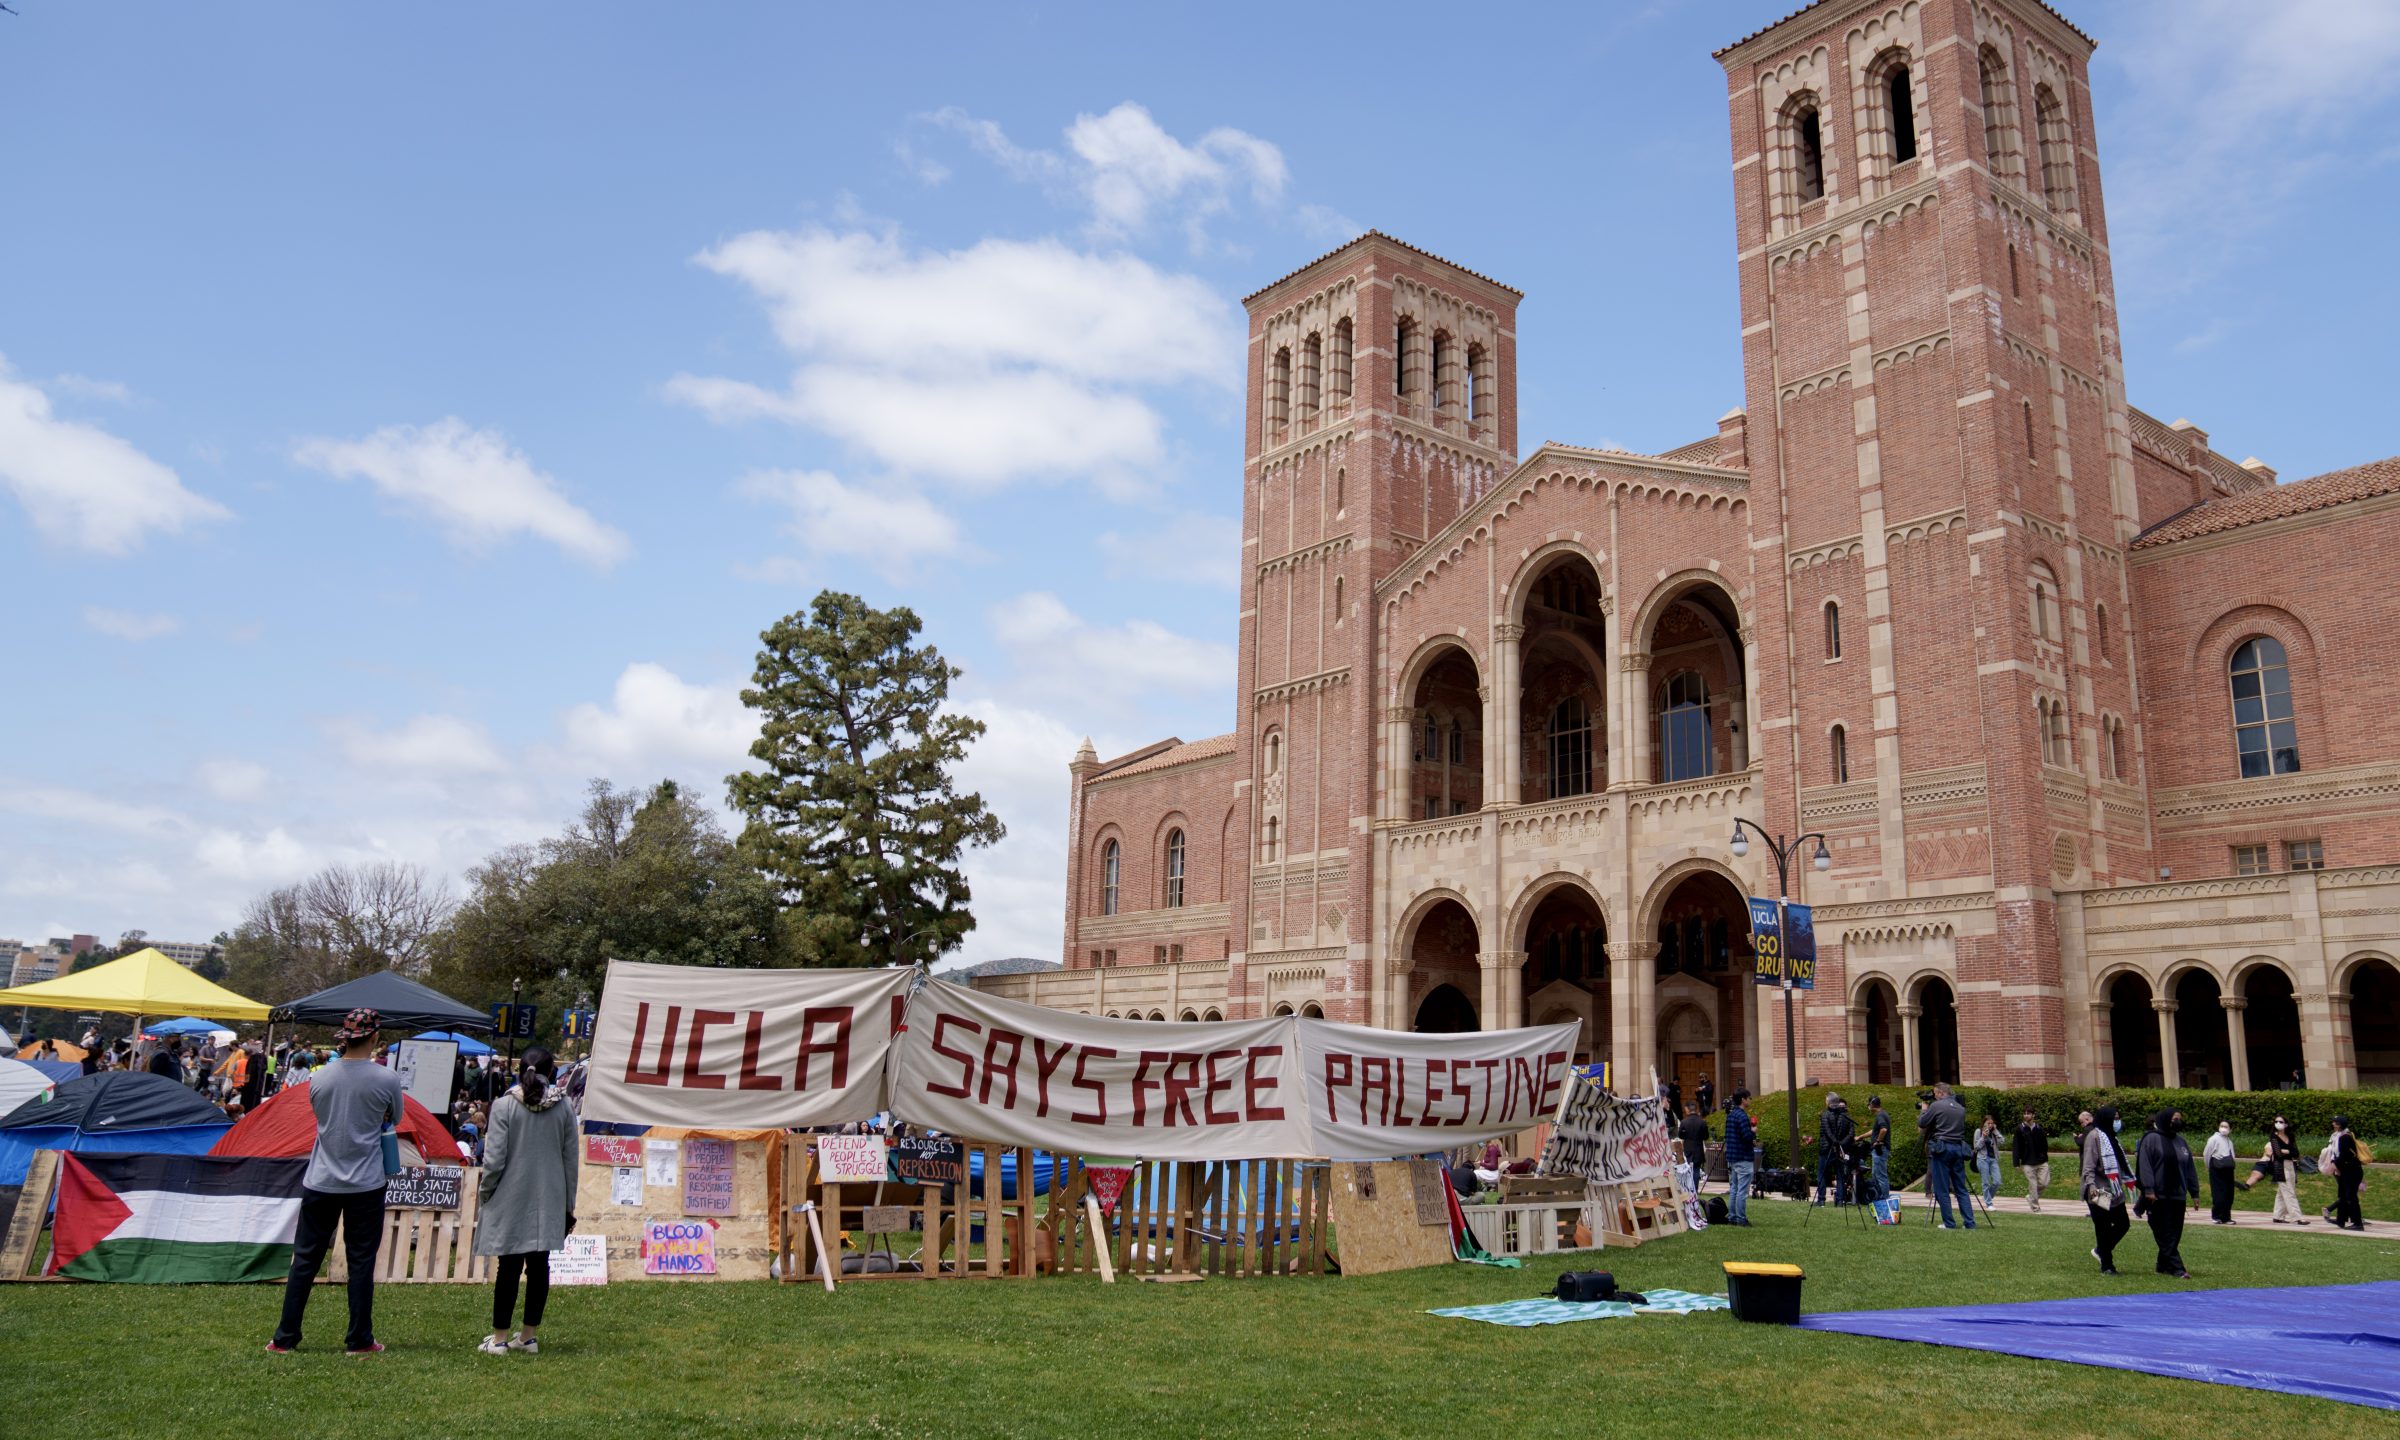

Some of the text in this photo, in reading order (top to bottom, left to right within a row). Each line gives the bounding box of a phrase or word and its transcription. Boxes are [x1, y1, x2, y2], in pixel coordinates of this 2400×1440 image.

[1753, 911, 1778, 926] UCLA
[1757, 935, 1778, 954] GO
[520, 1007, 531, 1034] UCLA
[1830, 1051, 1845, 1059] HALL
[624, 1001, 854, 1091] UCLA
[926, 1012, 1117, 1125] SAYS
[1131, 1045, 1285, 1127] FREE
[1325, 1051, 1567, 1127] PALESTINE
[591, 1136, 618, 1145] STAND
[822, 1137, 867, 1150] DEFEND
[900, 1138, 955, 1154] RESOURCES
[603, 1145, 626, 1153] WITH
[694, 1143, 725, 1154] WHEN
[611, 1153, 641, 1165] YEMEN
[695, 1153, 727, 1165] PEOPLE
[830, 1150, 877, 1163] PEOPLE'S
[920, 1151, 937, 1160] NOT
[430, 1167, 463, 1178] TERRORISM
[700, 1164, 715, 1173] ARE
[835, 1162, 887, 1176] STRUGGLE!
[899, 1159, 962, 1180] REPRESSION
[387, 1179, 453, 1191] OMBAT STATE
[689, 1181, 732, 1193] RESISTANCE
[385, 1191, 456, 1205] REPRESSION!
[686, 1196, 730, 1209] JUSTIFIED!
[653, 1225, 703, 1239] BLOOD
[658, 1254, 703, 1270] HANDS
